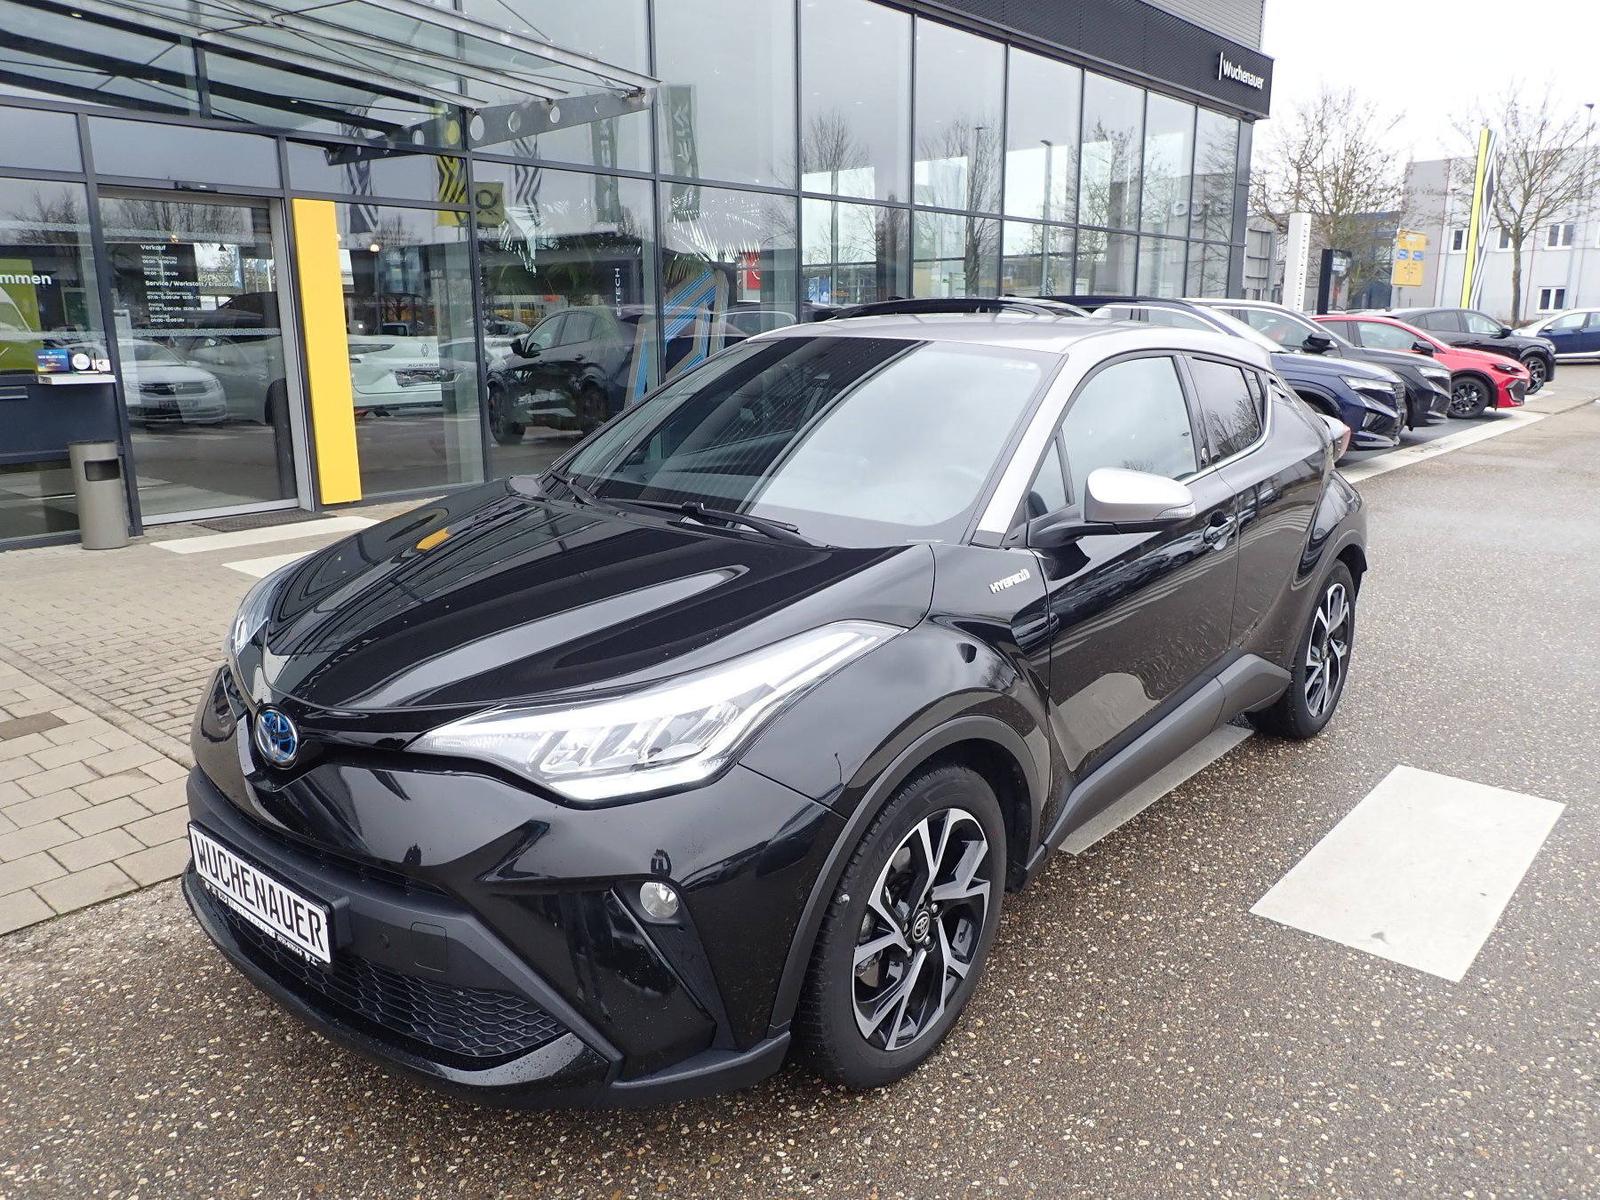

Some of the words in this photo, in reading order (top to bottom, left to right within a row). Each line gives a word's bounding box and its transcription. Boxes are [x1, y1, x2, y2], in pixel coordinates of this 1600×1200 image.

[1223, 59, 1264, 90] Wuchenauer
[0, 274, 52, 284] mmen
[194, 834, 325, 953] WUCHENAUER
